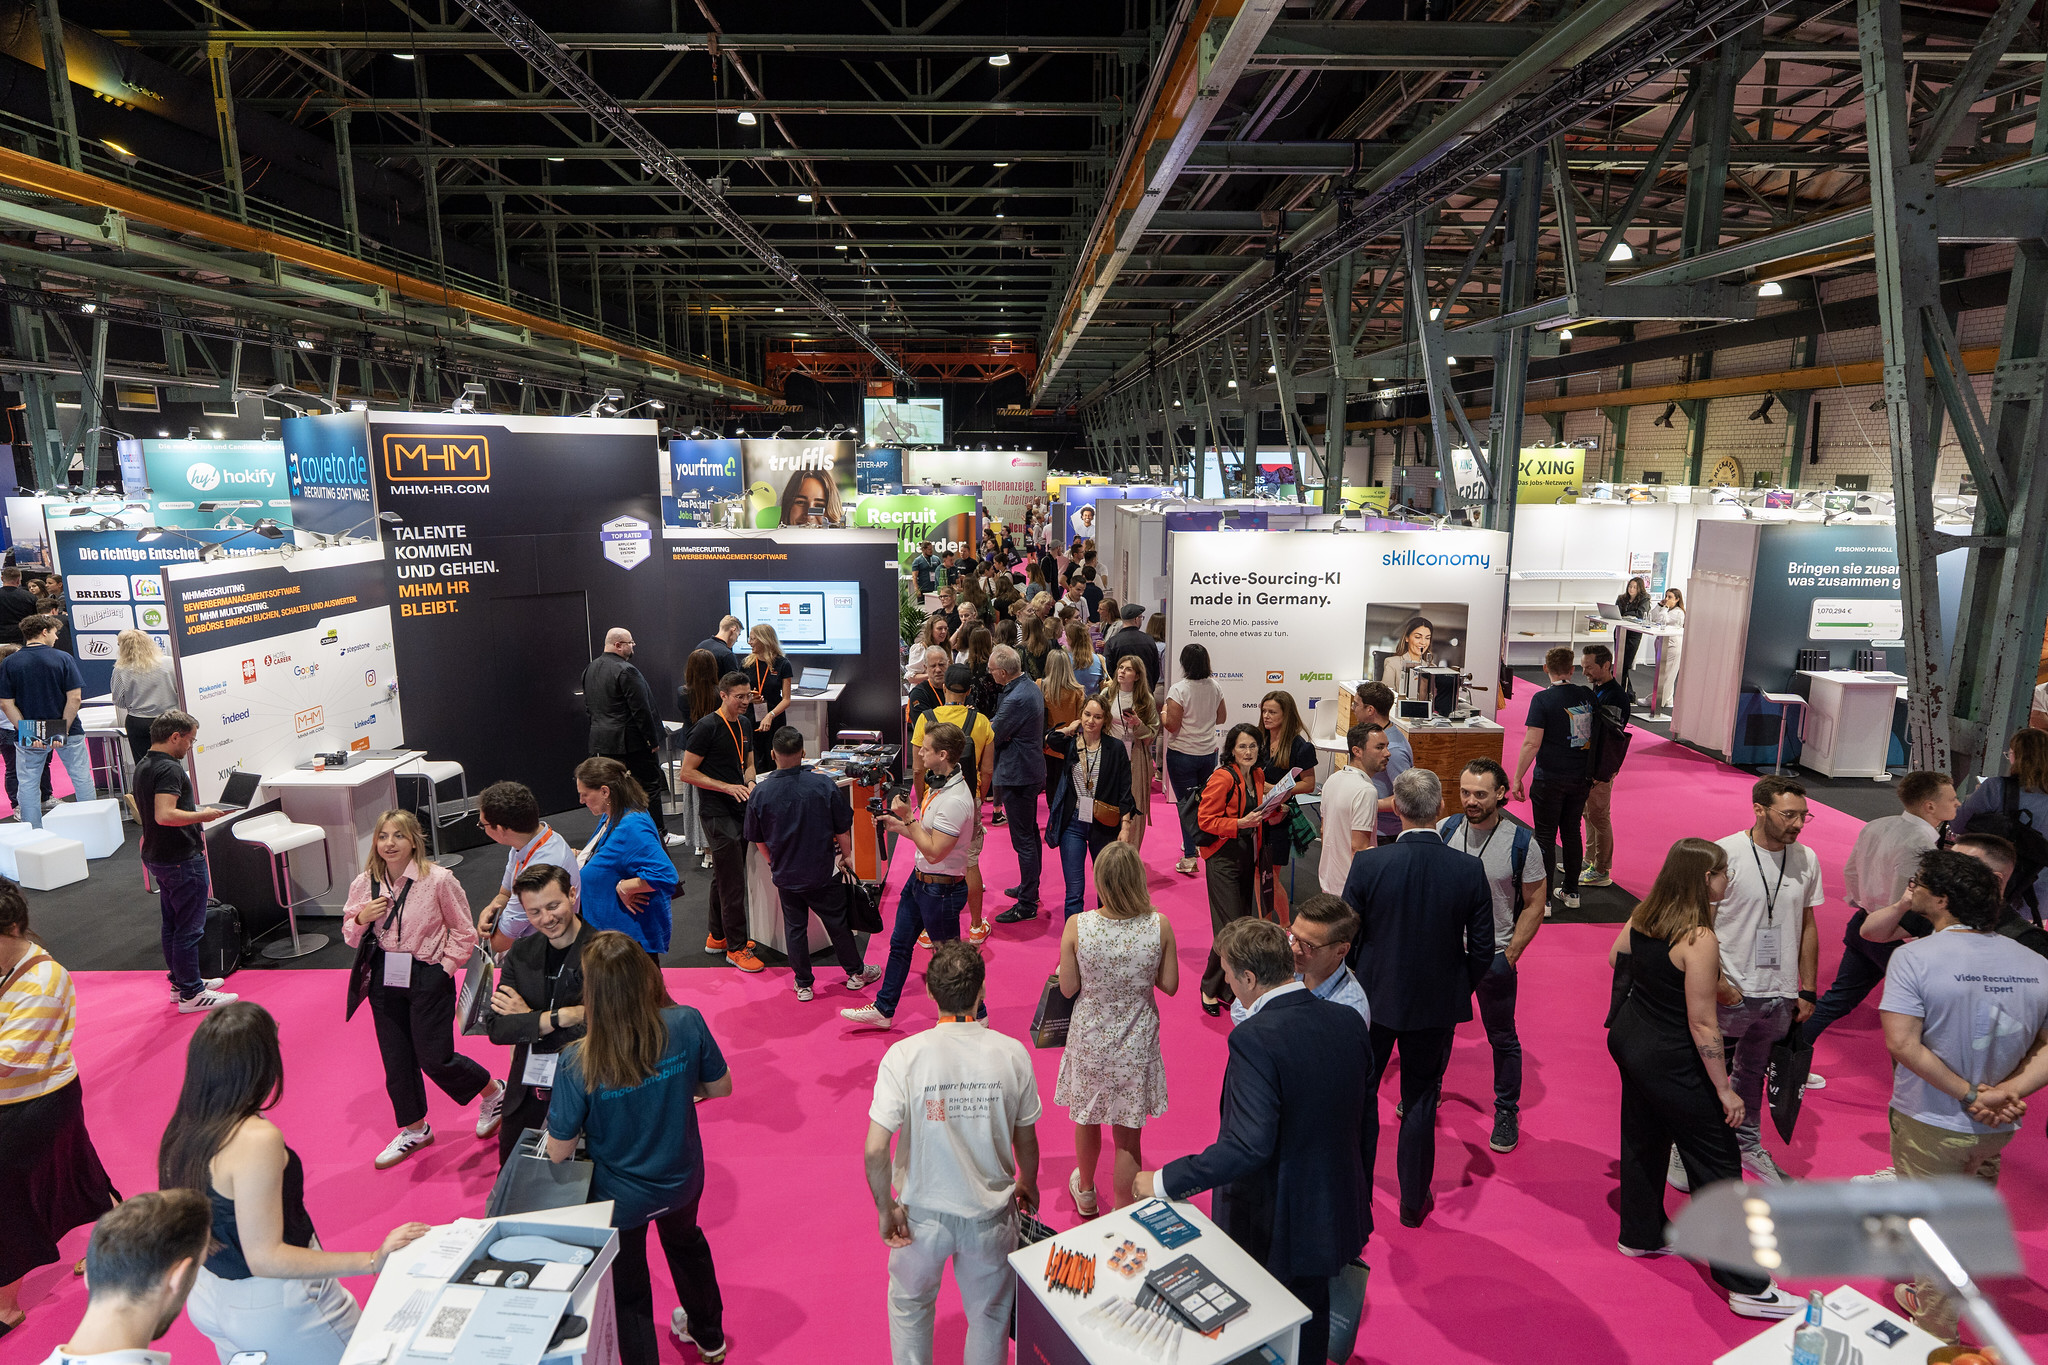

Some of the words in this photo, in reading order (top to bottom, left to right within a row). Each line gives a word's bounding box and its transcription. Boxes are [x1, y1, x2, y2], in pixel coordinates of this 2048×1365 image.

[301, 446, 368, 484] coveto.de
[394, 444, 480, 471] MHM
[768, 446, 834, 470] truffls
[675, 457, 724, 480] yourfirm
[1536, 461, 1574, 475] XING
[223, 469, 276, 488] hokify
[980, 480, 1036, 492] Stellenanzeige.
[304, 486, 336, 499] RECRUITING
[336, 488, 370, 502] SOFTWARE
[390, 484, 490, 494] MHM-HR.COM
[678, 499, 689, 508] Das
[678, 510, 692, 520] Jobs
[867, 507, 936, 523] Recruit
[392, 525, 466, 540] TALENTE
[79, 548, 99, 560] Die
[100, 547, 147, 562] richtige
[395, 543, 472, 560] KOMMEN
[1382, 550, 1490, 569] skillconomy
[397, 564, 436, 578] UND
[440, 560, 500, 576] GEHEN.
[1788, 562, 1840, 576] Bringen
[1842, 563, 1862, 574] sie
[1190, 572, 1341, 588] Active-Sourcing-KI
[1788, 578, 1815, 586] was
[1817, 578, 1890, 587] zusammen
[182, 584, 245, 601] MHMeRECRUITING
[399, 582, 443, 598] MHM
[447, 580, 470, 595] HR
[184, 586, 300, 612] BEWERBERMANAGEMENT-SOFTWARE
[1190, 593, 1233, 606] made
[1238, 592, 1251, 605] in
[1256, 592, 1331, 607] Germany.
[185, 614, 199, 624] MIT
[200, 610, 218, 621] MHM
[220, 602, 269, 618] MULTIPOSTING.
[186, 620, 225, 635] JOBBÖRSE
[226, 616, 252, 628] EINFACH
[254, 611, 281, 623] BUCHEN,
[281, 605, 310, 617] SCHALTEN
[311, 602, 324, 611] UND
[324, 596, 358, 608] AUSWERTEN.
[401, 600, 459, 617] BLEIBT.
[81, 608, 124, 627] Underberg
[1189, 618, 1219, 626] Erreiche
[1252, 619, 1278, 627] passive
[1189, 630, 1218, 638] Talente,
[89, 642, 108, 653] ille
[274, 656, 291, 665] CAREER
[294, 662, 319, 676] Google
[1300, 671, 1332, 682] WAGO
[199, 684, 221, 693] Diakonie
[200, 689, 226, 700] Deutschland
[222, 708, 249, 725] indeed
[298, 710, 321, 728] MHM
[1954, 974, 1981, 982] Video
[1983, 975, 2040, 984] Recruitment
[1984, 985, 2014, 994] Expert
